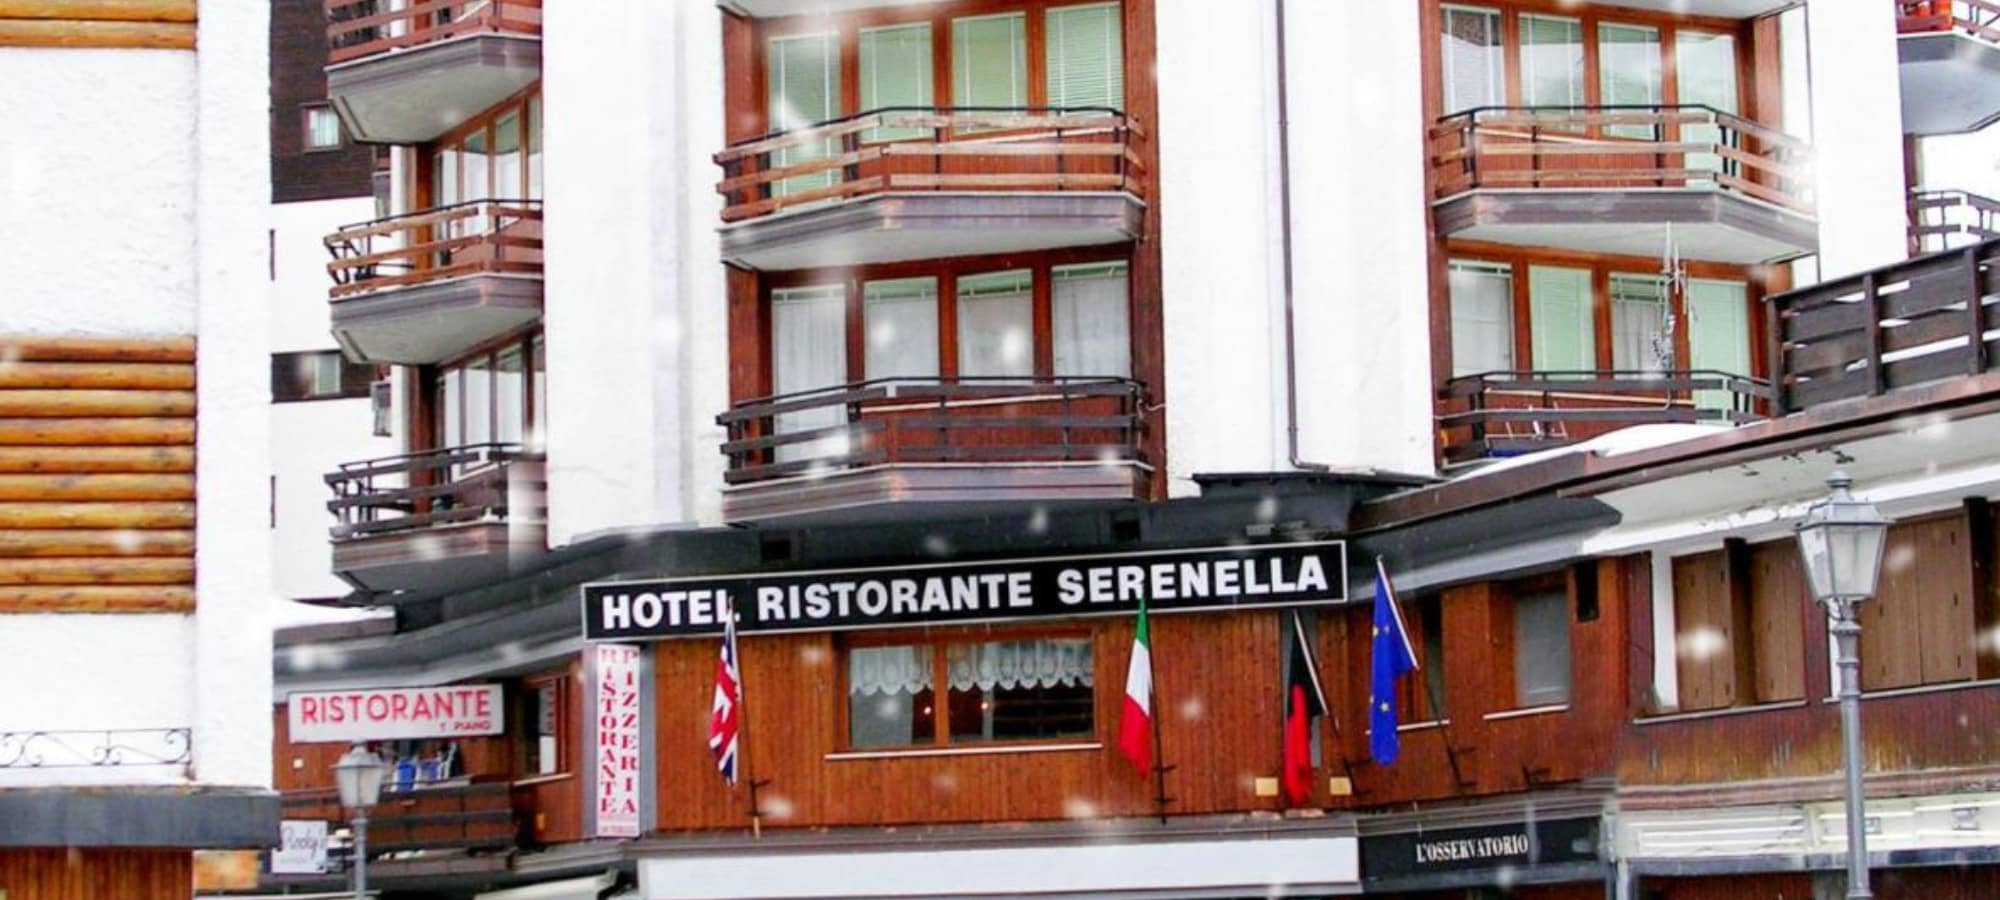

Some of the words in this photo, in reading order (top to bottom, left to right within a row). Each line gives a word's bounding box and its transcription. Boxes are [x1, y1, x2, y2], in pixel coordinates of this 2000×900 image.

[602, 588, 741, 630] HOTEL
[757, 571, 1033, 622] RISTORANTE
[1056, 555, 1328, 605] SERENELLA
[300, 690, 492, 724] RISTORANTE
[600, 646, 617, 812] RISTORANTE
[621, 646, 640, 813] PIZZERIA
[1416, 834, 1528, 863] L'OSSERVATORIO
